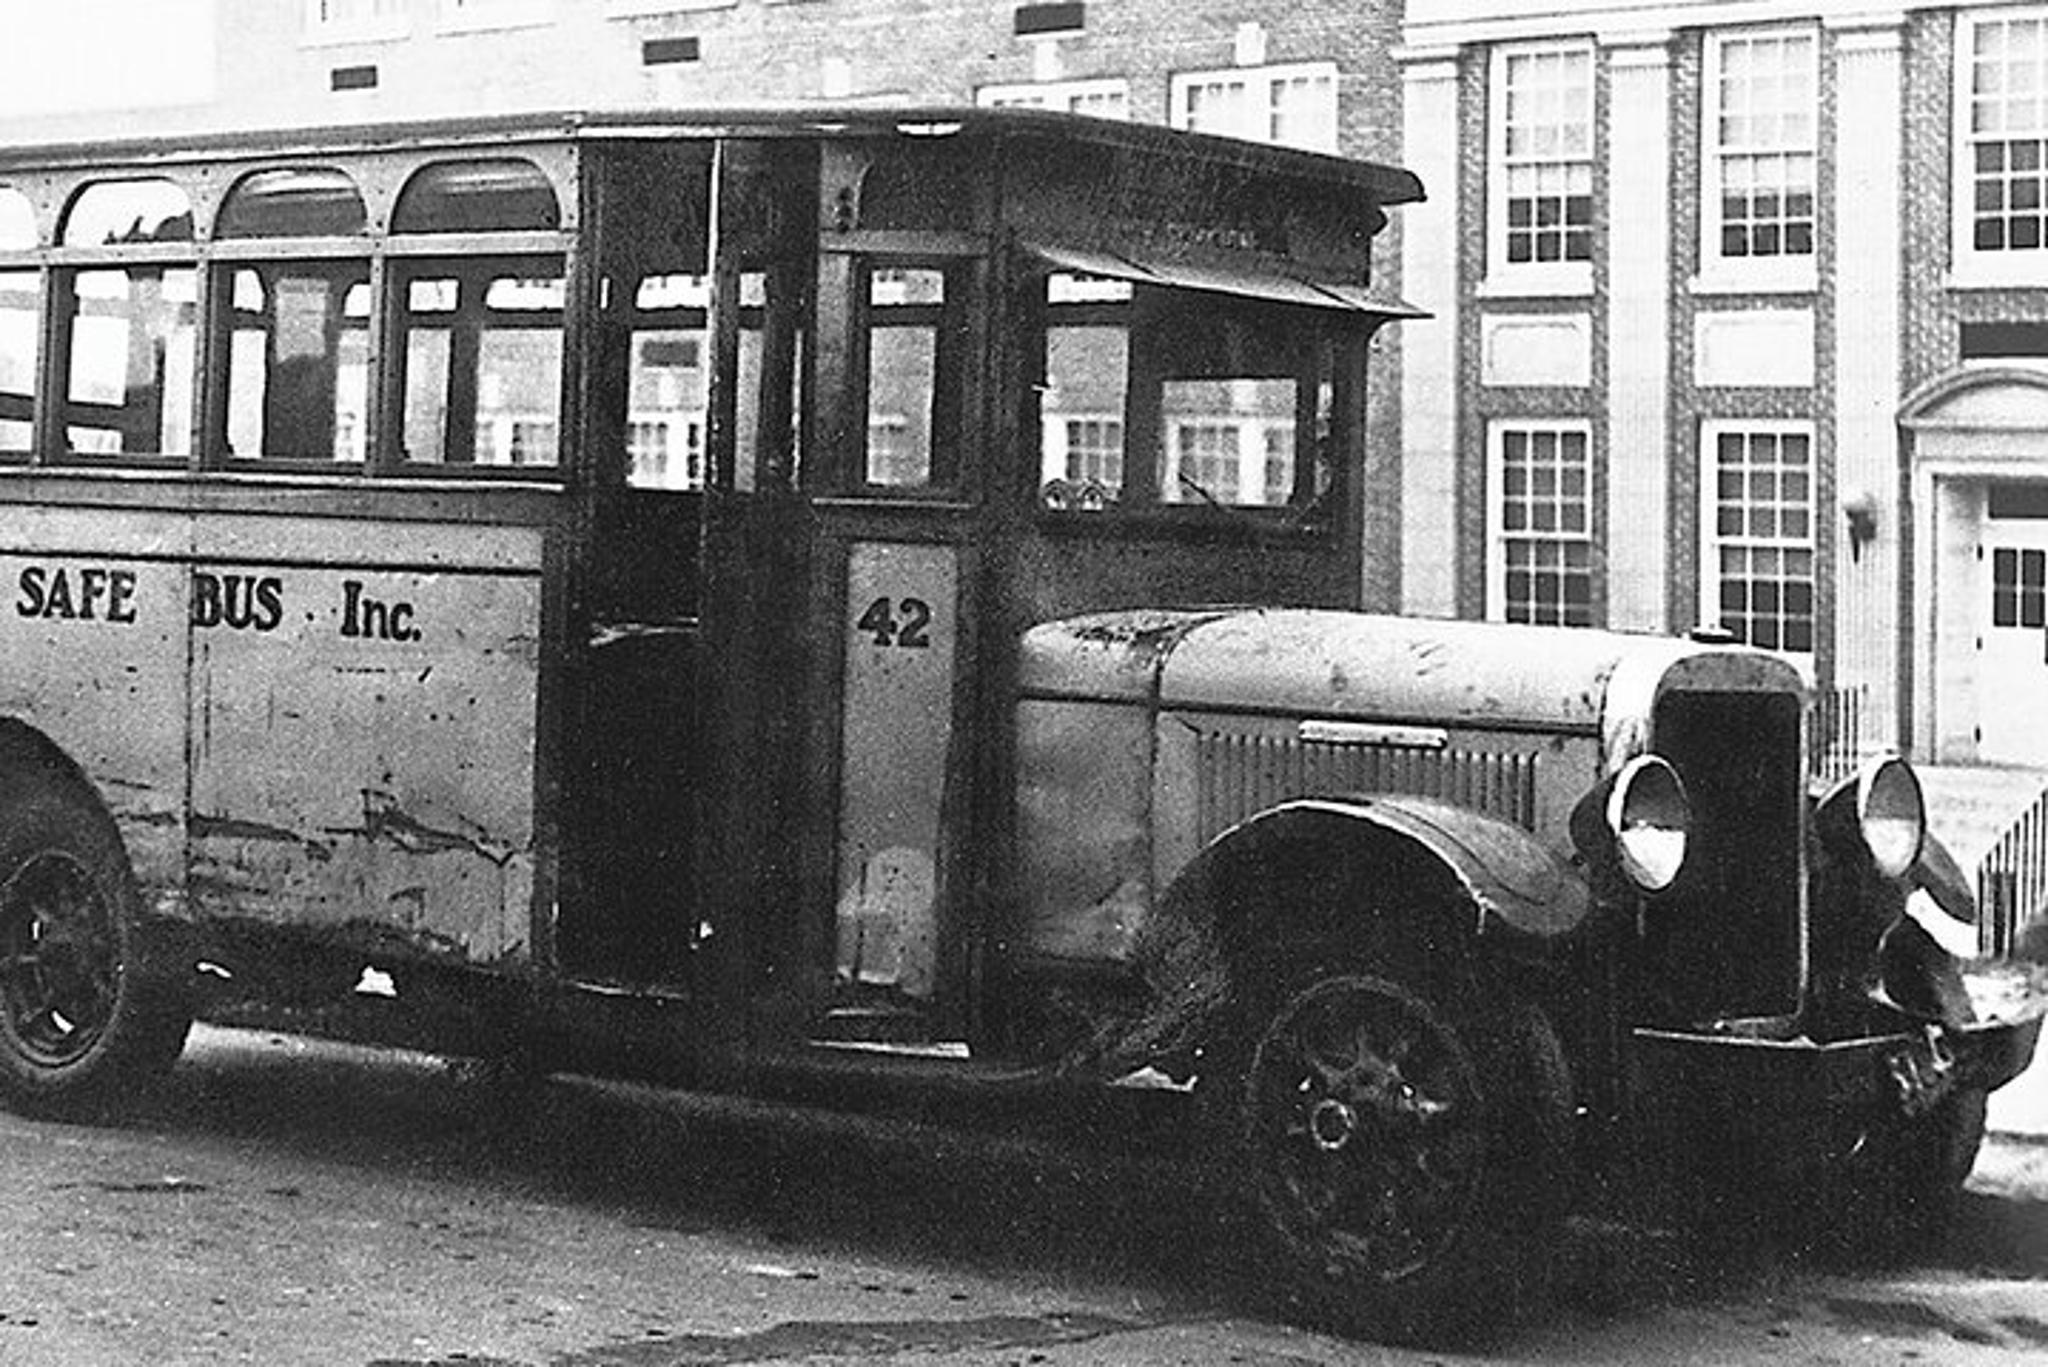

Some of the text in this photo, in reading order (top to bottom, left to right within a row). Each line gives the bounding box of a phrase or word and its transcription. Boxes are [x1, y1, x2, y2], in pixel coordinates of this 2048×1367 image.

[17, 566, 422, 641] SAFE BUS Inc.
[858, 597, 930, 647] 42
